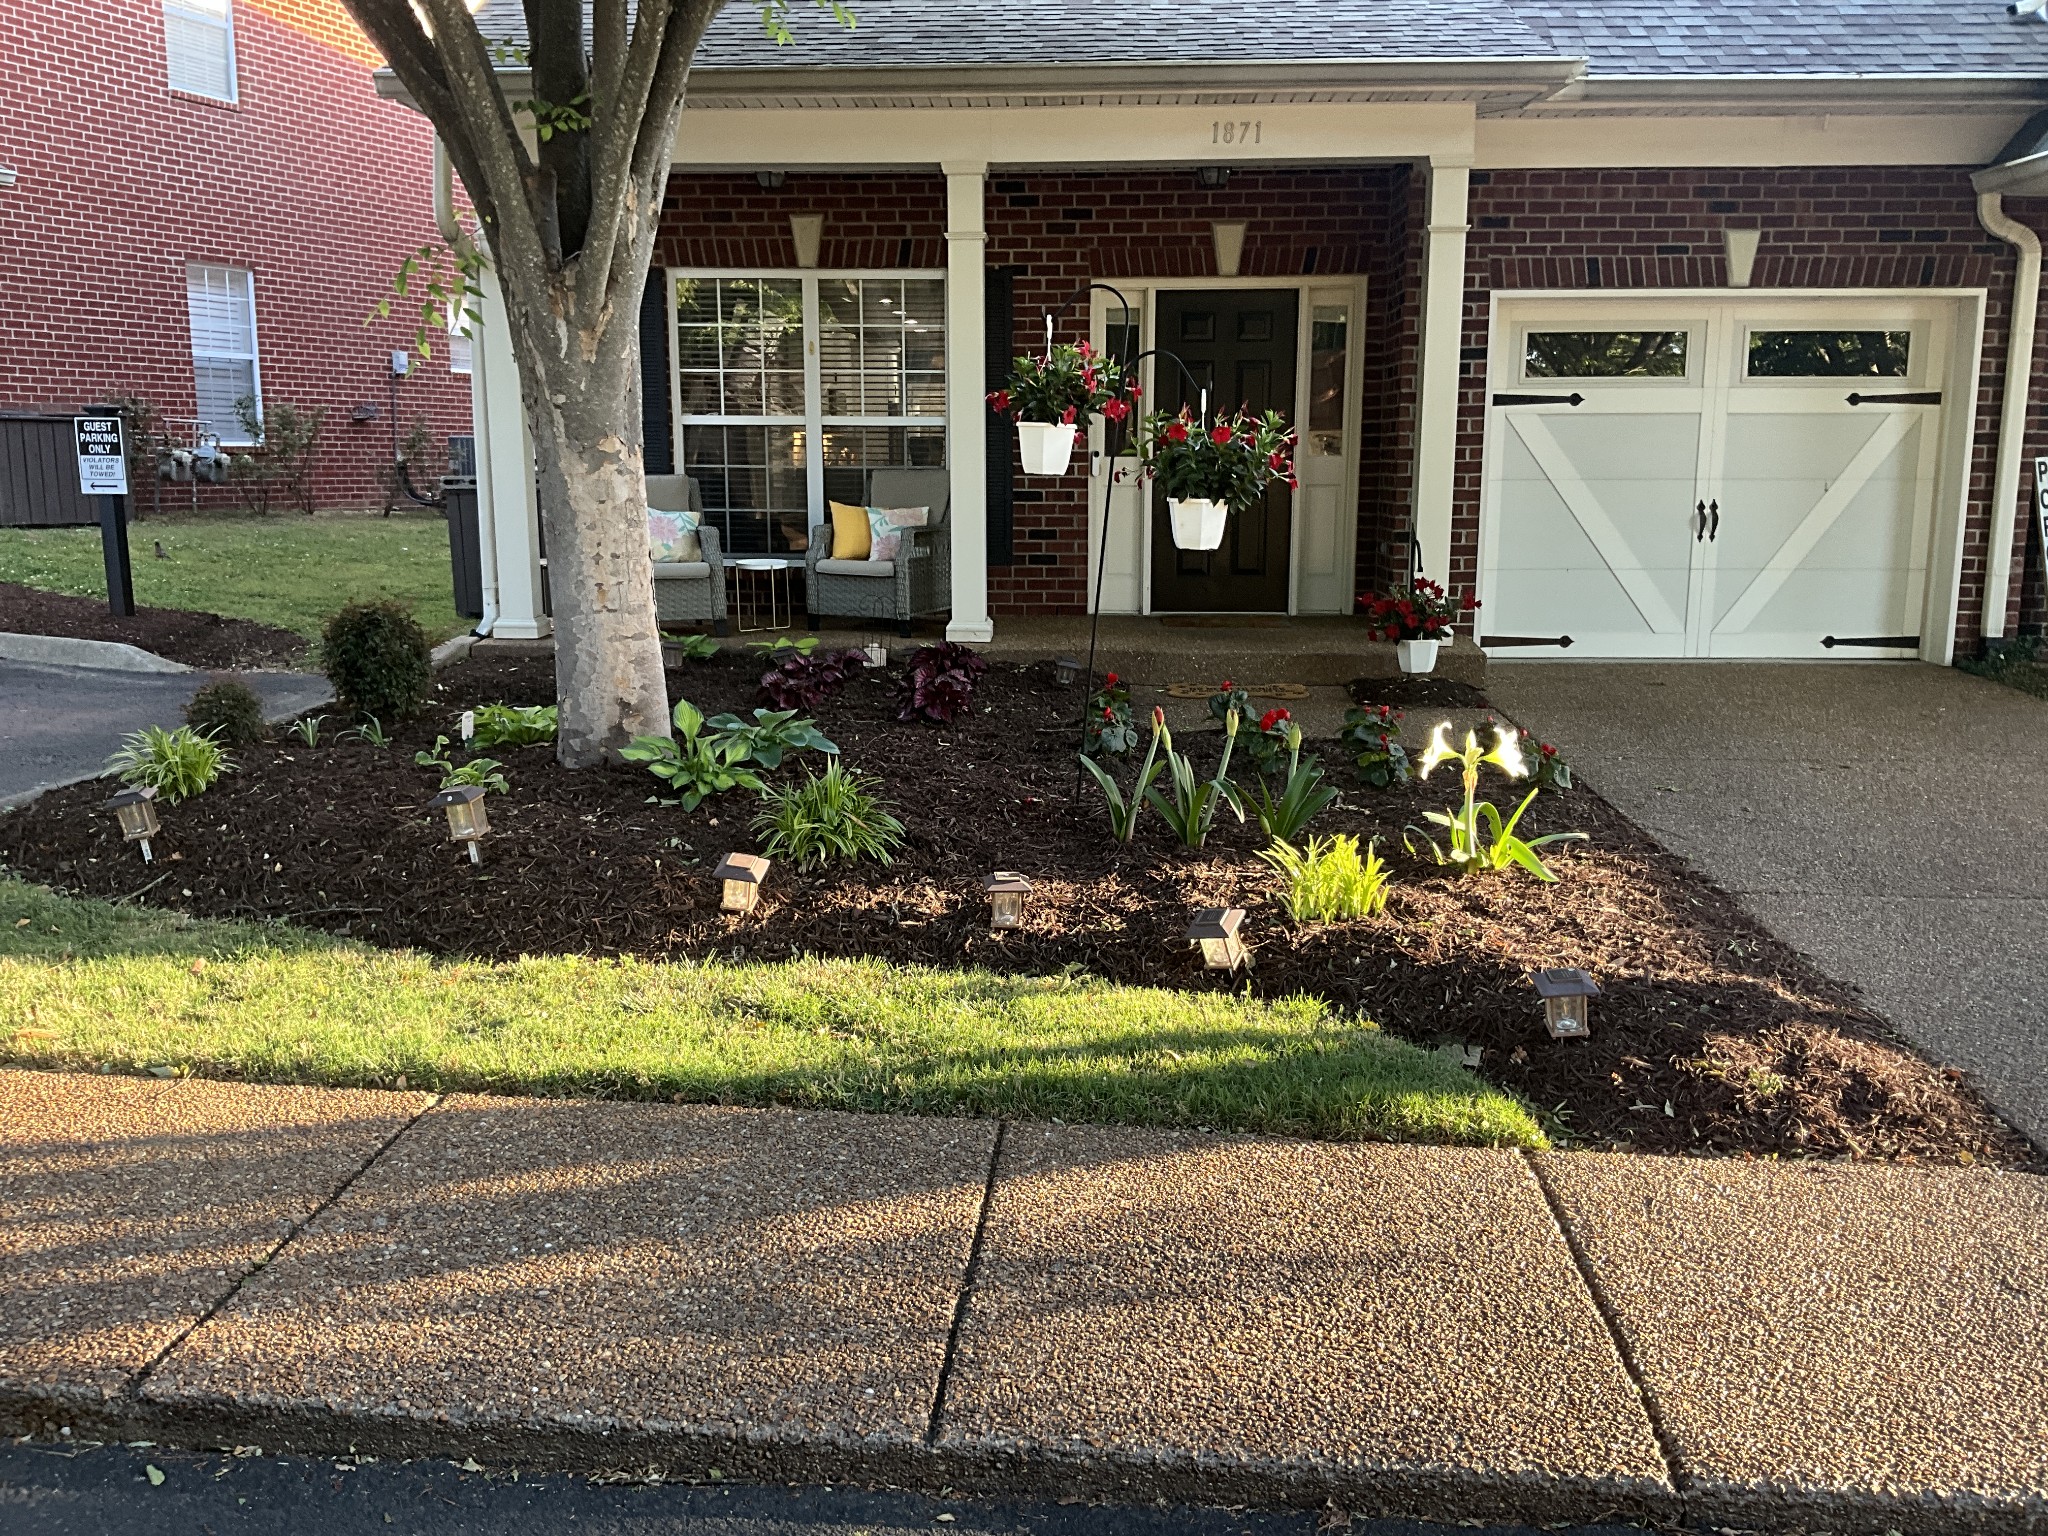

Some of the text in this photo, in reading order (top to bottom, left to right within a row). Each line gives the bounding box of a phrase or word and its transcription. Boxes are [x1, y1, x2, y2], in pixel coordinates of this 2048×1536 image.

[1212, 121, 1262, 144] 1871
[83, 422, 112, 431] GUEST
[80, 433, 118, 442] PARKING
[88, 444, 111, 453] ONLY
